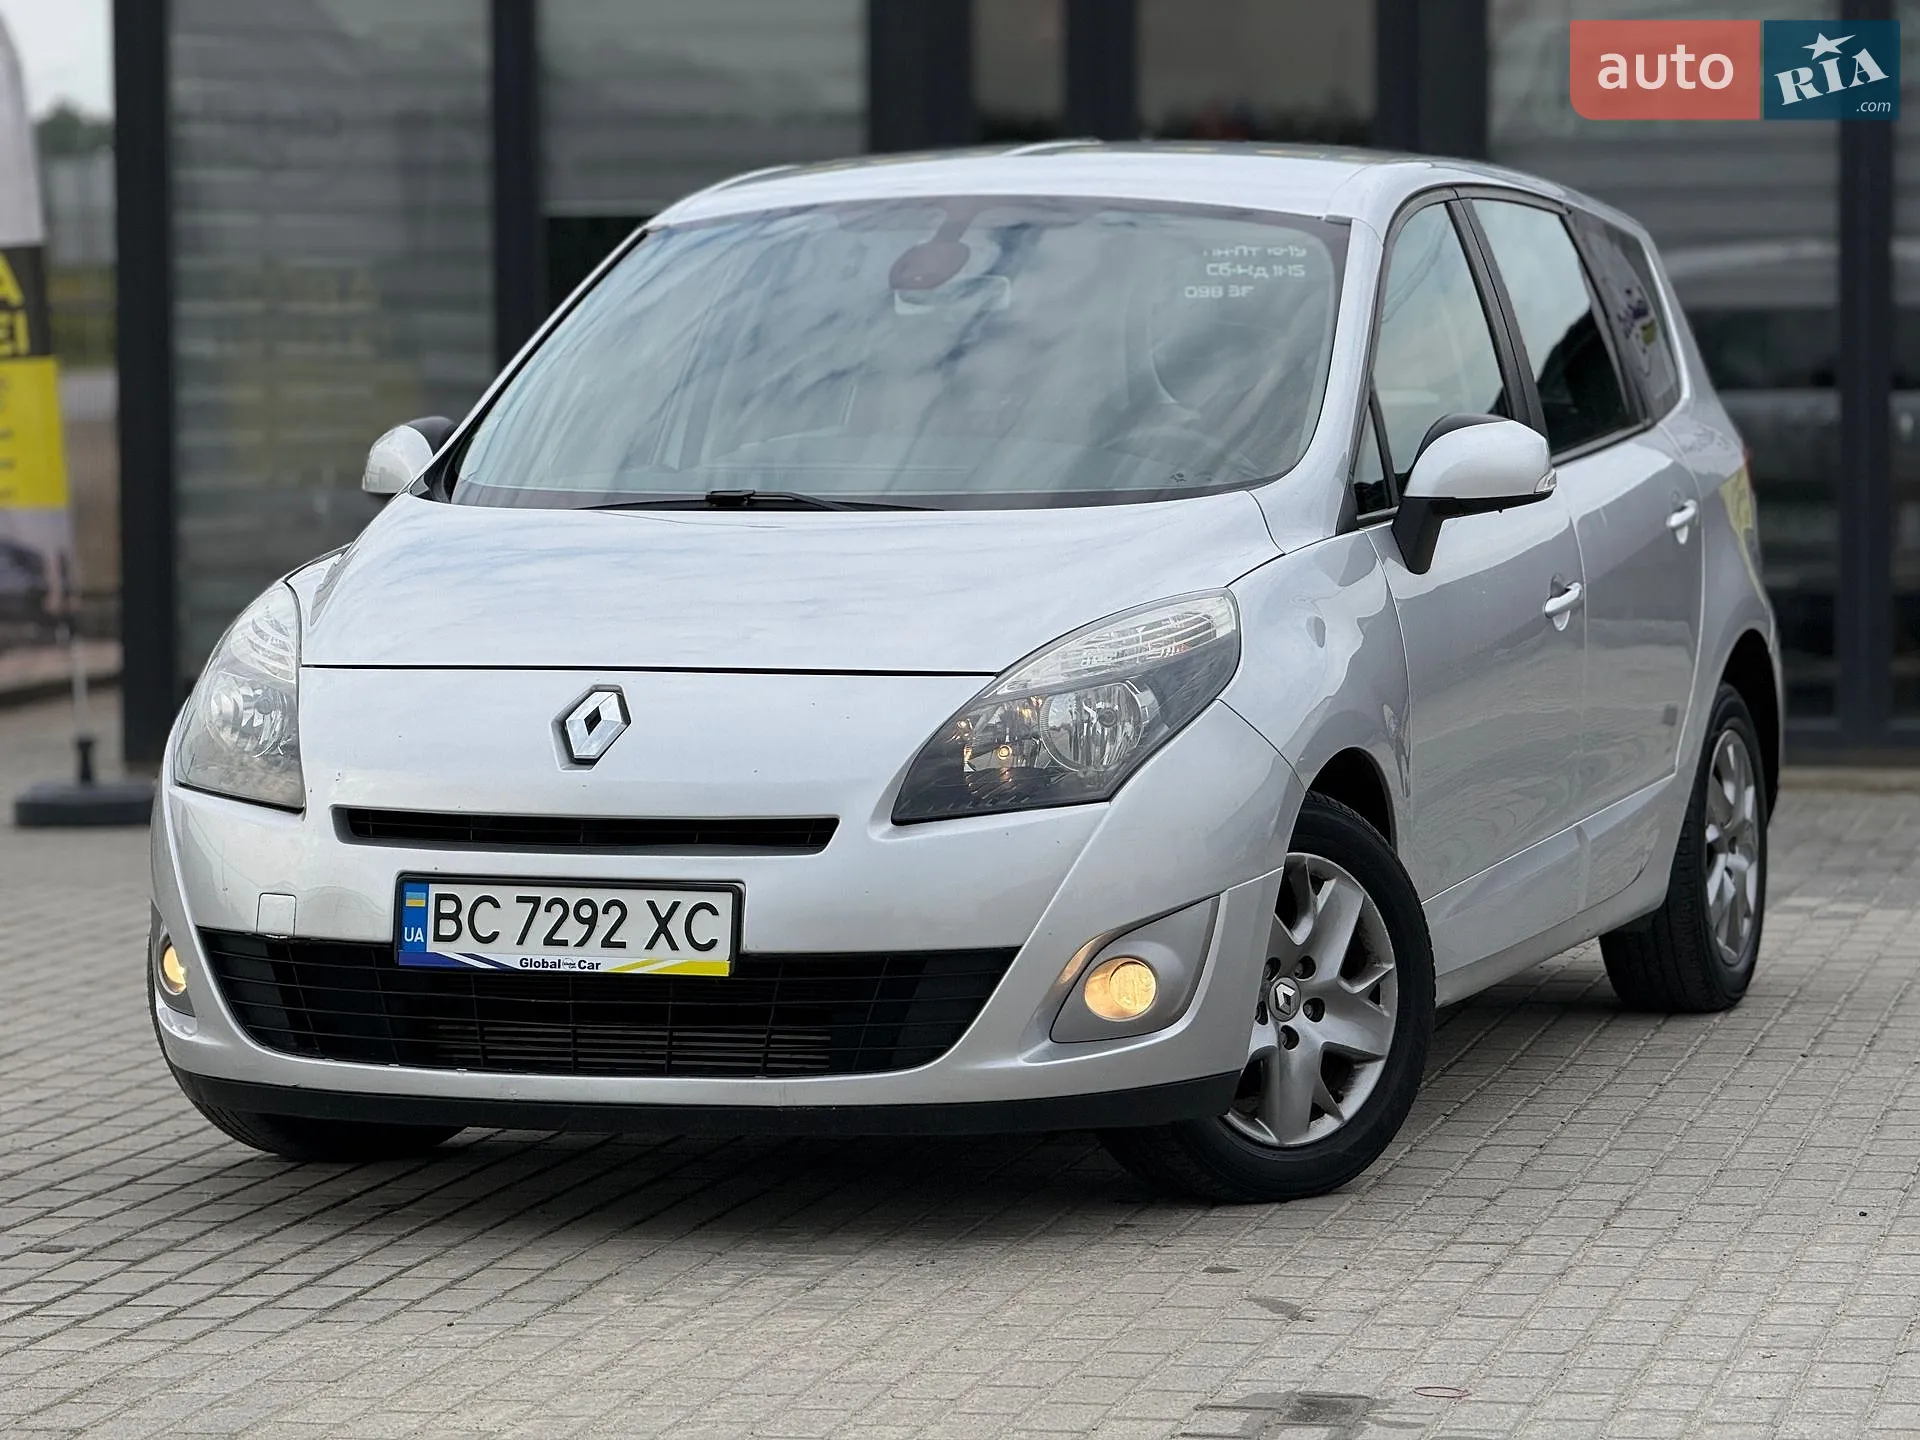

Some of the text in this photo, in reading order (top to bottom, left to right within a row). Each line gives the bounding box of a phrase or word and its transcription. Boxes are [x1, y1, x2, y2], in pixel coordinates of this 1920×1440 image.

[433, 893, 719, 951] BC 7292 XC
[404, 926, 424, 943] UA
[519, 957, 561, 969] Global
[577, 959, 601, 971] Car
